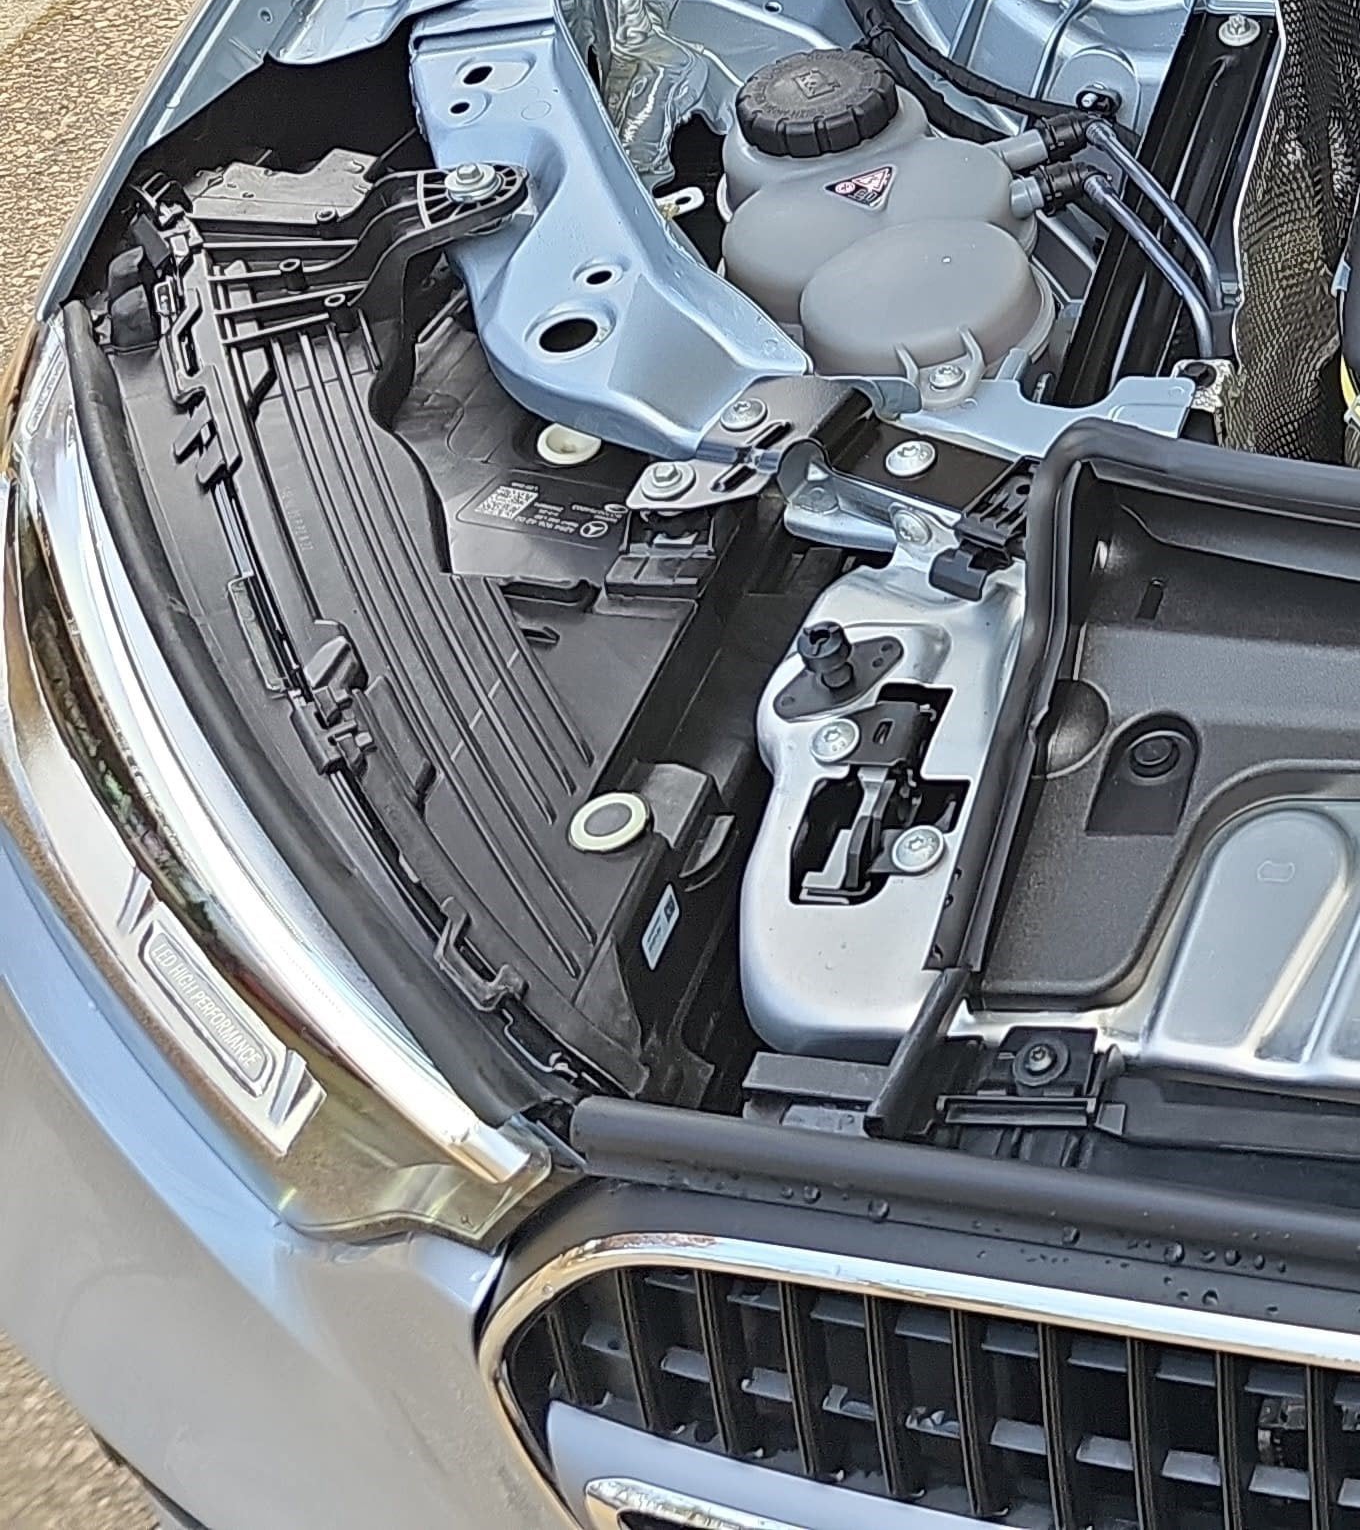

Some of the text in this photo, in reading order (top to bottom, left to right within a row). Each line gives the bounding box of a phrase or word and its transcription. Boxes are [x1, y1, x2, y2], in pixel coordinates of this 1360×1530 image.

[152, 942, 262, 1068] LED HIGH PERFORMANCE
